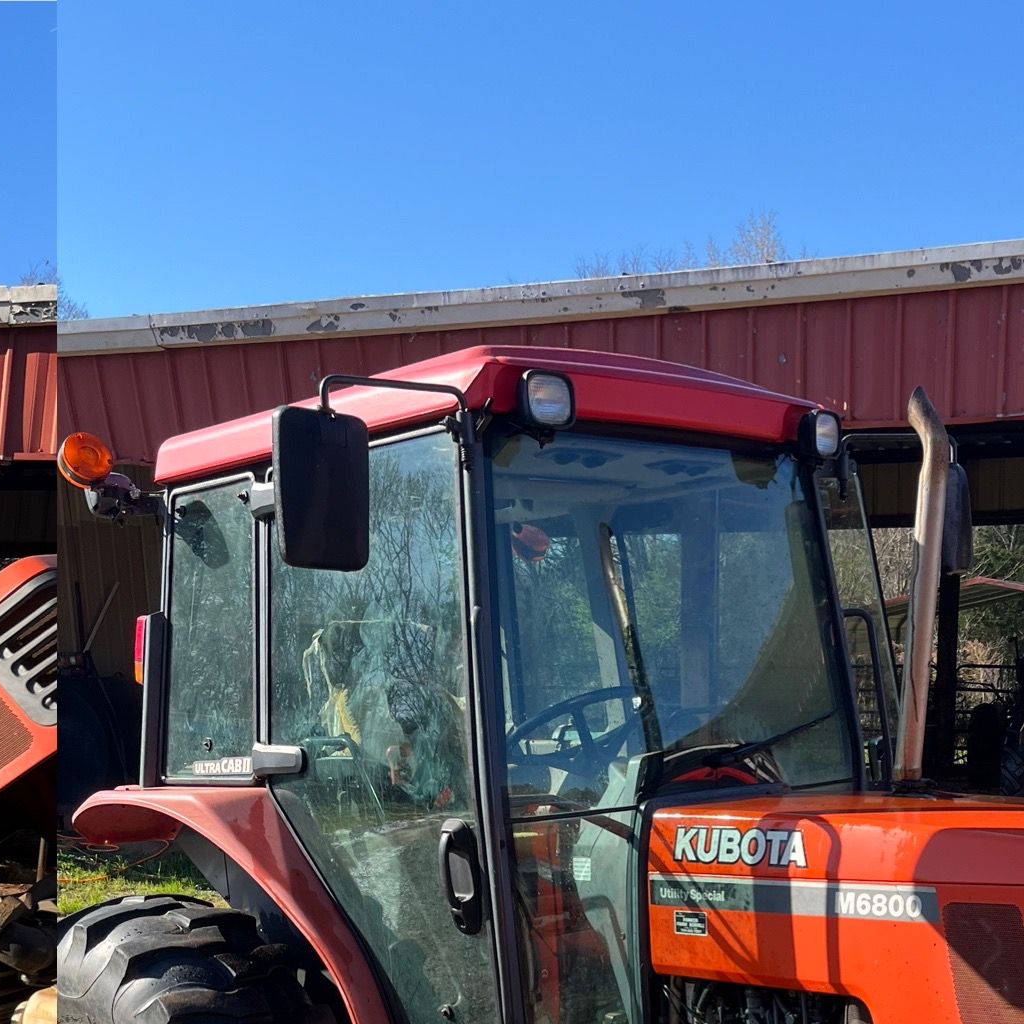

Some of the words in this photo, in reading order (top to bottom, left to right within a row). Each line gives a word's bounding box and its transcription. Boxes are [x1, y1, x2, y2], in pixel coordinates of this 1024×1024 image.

[195, 761, 221, 774] ULTRA
[673, 826, 807, 868] KUBOTA
[660, 887, 689, 901] Utility
[690, 888, 725, 903] Special
[835, 891, 922, 918] M6800
